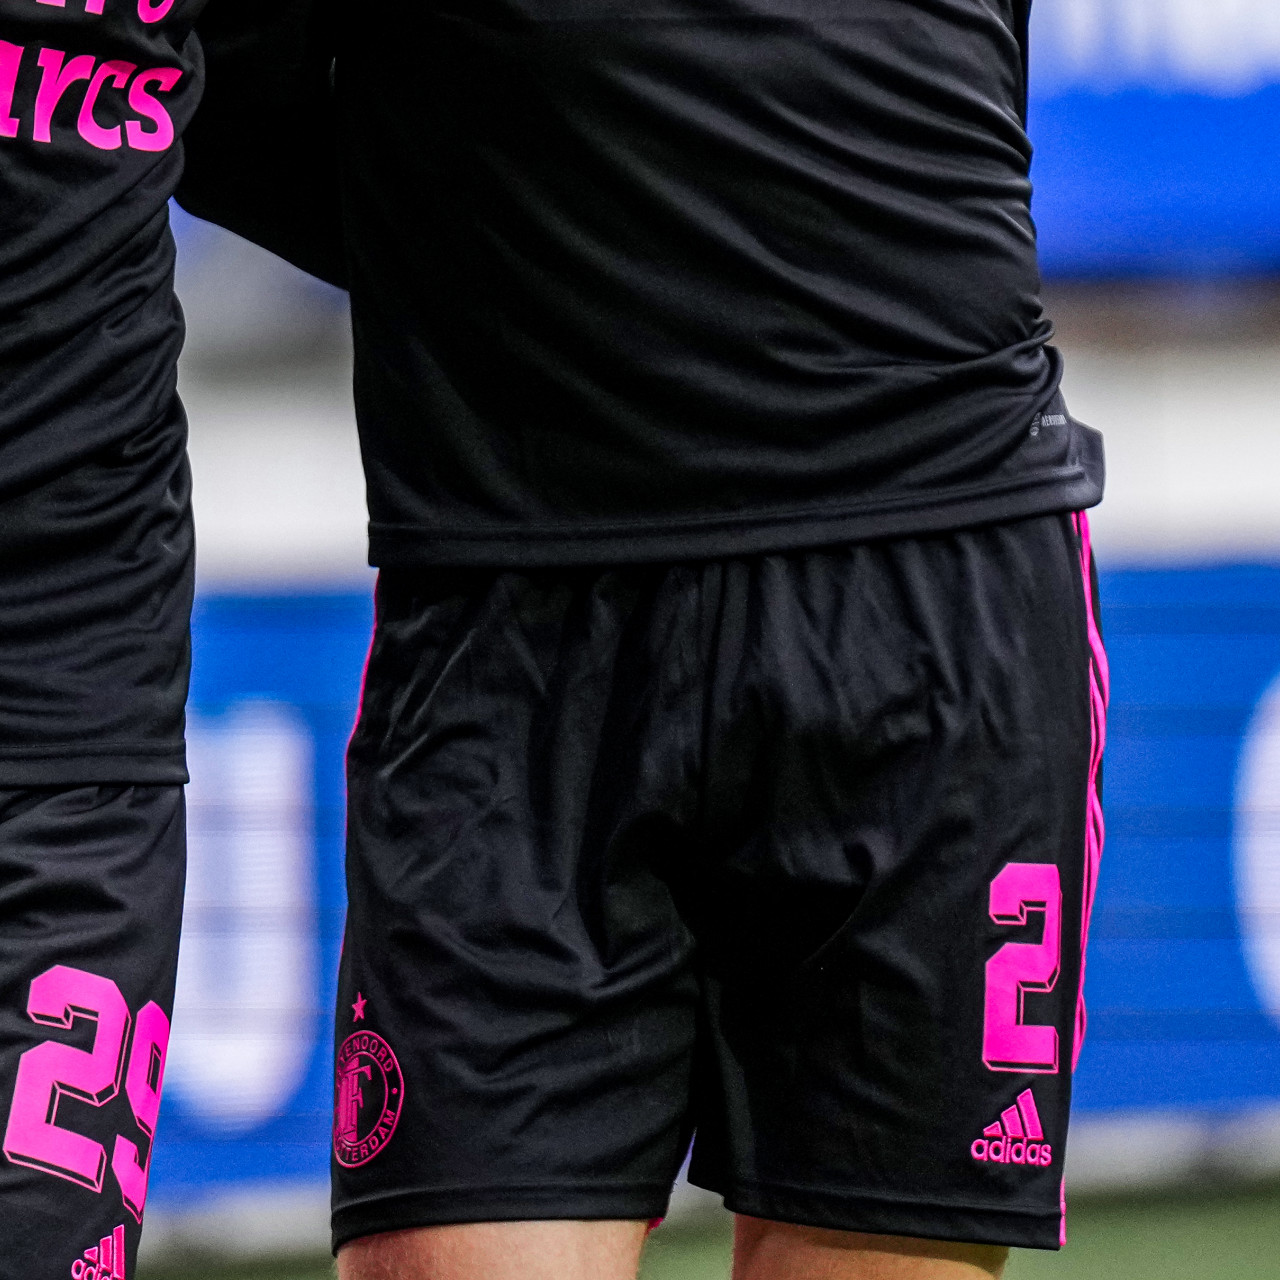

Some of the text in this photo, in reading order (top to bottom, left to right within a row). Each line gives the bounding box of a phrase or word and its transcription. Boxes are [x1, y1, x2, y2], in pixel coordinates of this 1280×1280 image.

[981, 862, 1063, 1074] 2
[2, 963, 170, 1225] 29
[970, 1134, 1052, 1167] adidas
